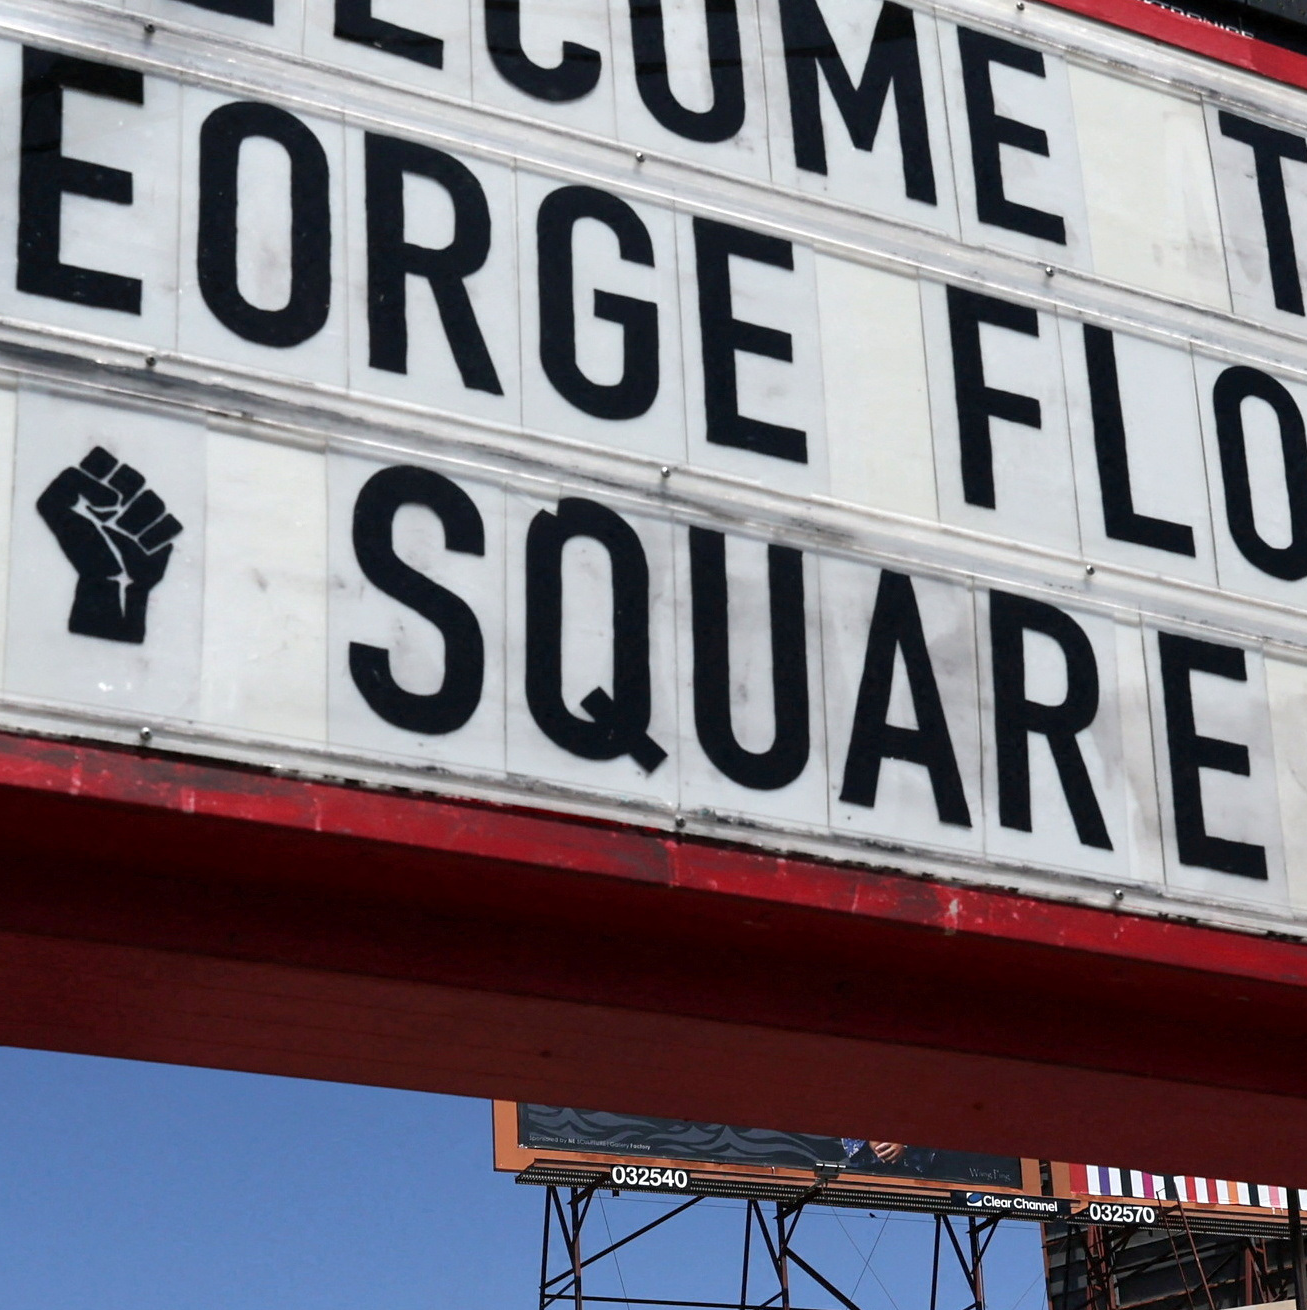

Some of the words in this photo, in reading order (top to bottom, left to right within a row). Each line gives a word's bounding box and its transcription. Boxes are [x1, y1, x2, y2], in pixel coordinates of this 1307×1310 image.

[349, 465, 1269, 880] SQUARE
[612, 1166, 688, 1189] 032540
[983, 1196, 1012, 1209] Clear
[1013, 1197, 1058, 1212] Channel
[1089, 1203, 1155, 1224] 032570
